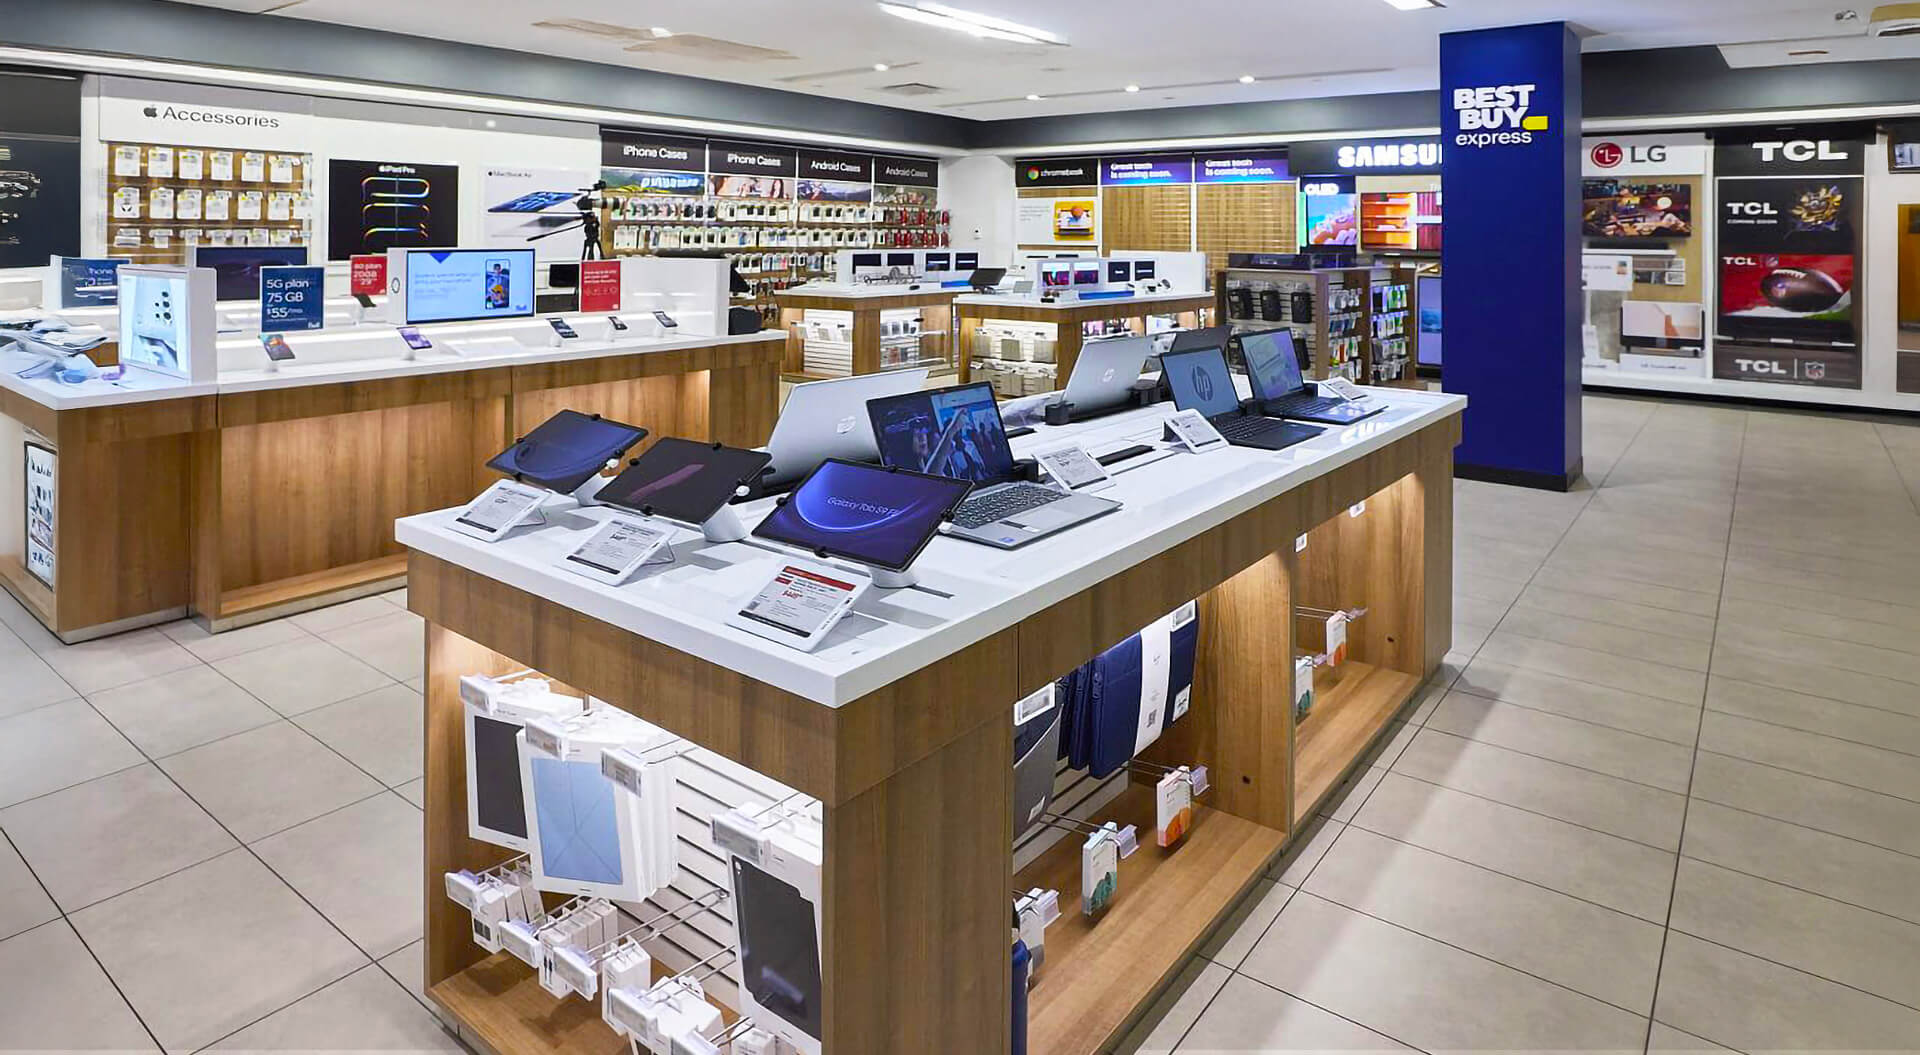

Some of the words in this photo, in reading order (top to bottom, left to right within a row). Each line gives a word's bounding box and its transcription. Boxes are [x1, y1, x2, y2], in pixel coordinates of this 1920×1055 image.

[1454, 84, 1535, 109] BEST
[162, 106, 280, 128] Accessories
[1459, 106, 1528, 130] BUY
[1455, 132, 1532, 148] express
[623, 145, 657, 158] iPhone
[658, 147, 688, 161] Cases
[1337, 143, 1443, 168] SAMSU
[1630, 145, 1667, 163] LG
[1752, 140, 1848, 162] TCL
[727, 153, 756, 165] iPhone
[757, 155, 781, 167] Cases
[811, 160, 839, 172] Android
[840, 162, 861, 173] Cases
[1205, 159, 1231, 168] Great
[1232, 159, 1253, 167] tech
[886, 166, 910, 177] Android
[911, 168, 928, 178] Cases
[1213, 167, 1248, 177] coming
[1249, 166, 1274, 176] soon.
[1726, 202, 1778, 215] TCL
[1723, 256, 1756, 266] TCL
[266, 279, 283, 289] 5G
[284, 279, 309, 291] plan
[267, 292, 283, 304] 75
[1734, 358, 1787, 374] TCL
[827, 496, 859, 510] Galaxy
